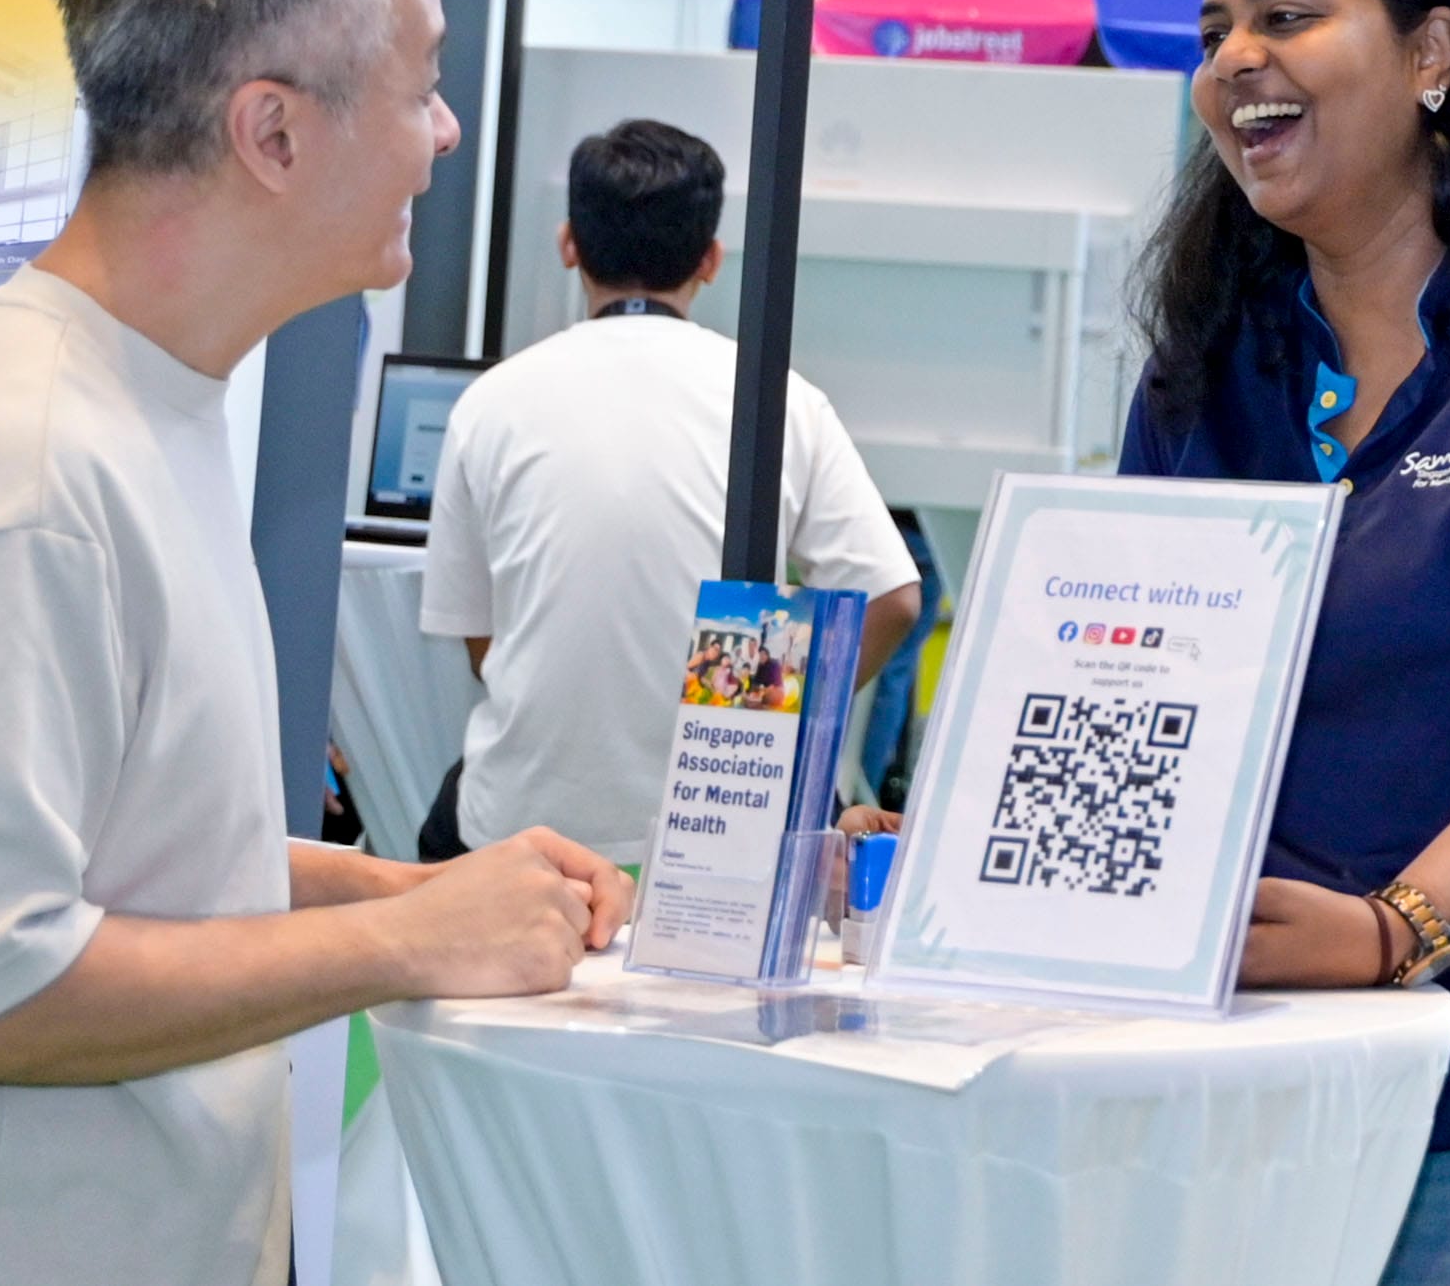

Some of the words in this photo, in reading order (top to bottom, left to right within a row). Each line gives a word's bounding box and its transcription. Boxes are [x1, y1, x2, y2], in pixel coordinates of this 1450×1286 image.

[1045, 576, 1140, 602] Connect
[1149, 581, 1199, 606] with
[1206, 588, 1242, 609] us!
[1074, 658, 1096, 670] Scan
[1100, 659, 1114, 671] the
[1117, 661, 1131, 672] QR
[1134, 662, 1157, 674] code
[1159, 664, 1170, 674] to
[1091, 676, 1129, 689] support
[682, 721, 775, 749] Singapore
[677, 751, 784, 780] Association
[673, 780, 700, 801] for
[705, 784, 770, 809] Mental
[668, 811, 727, 835] Health
